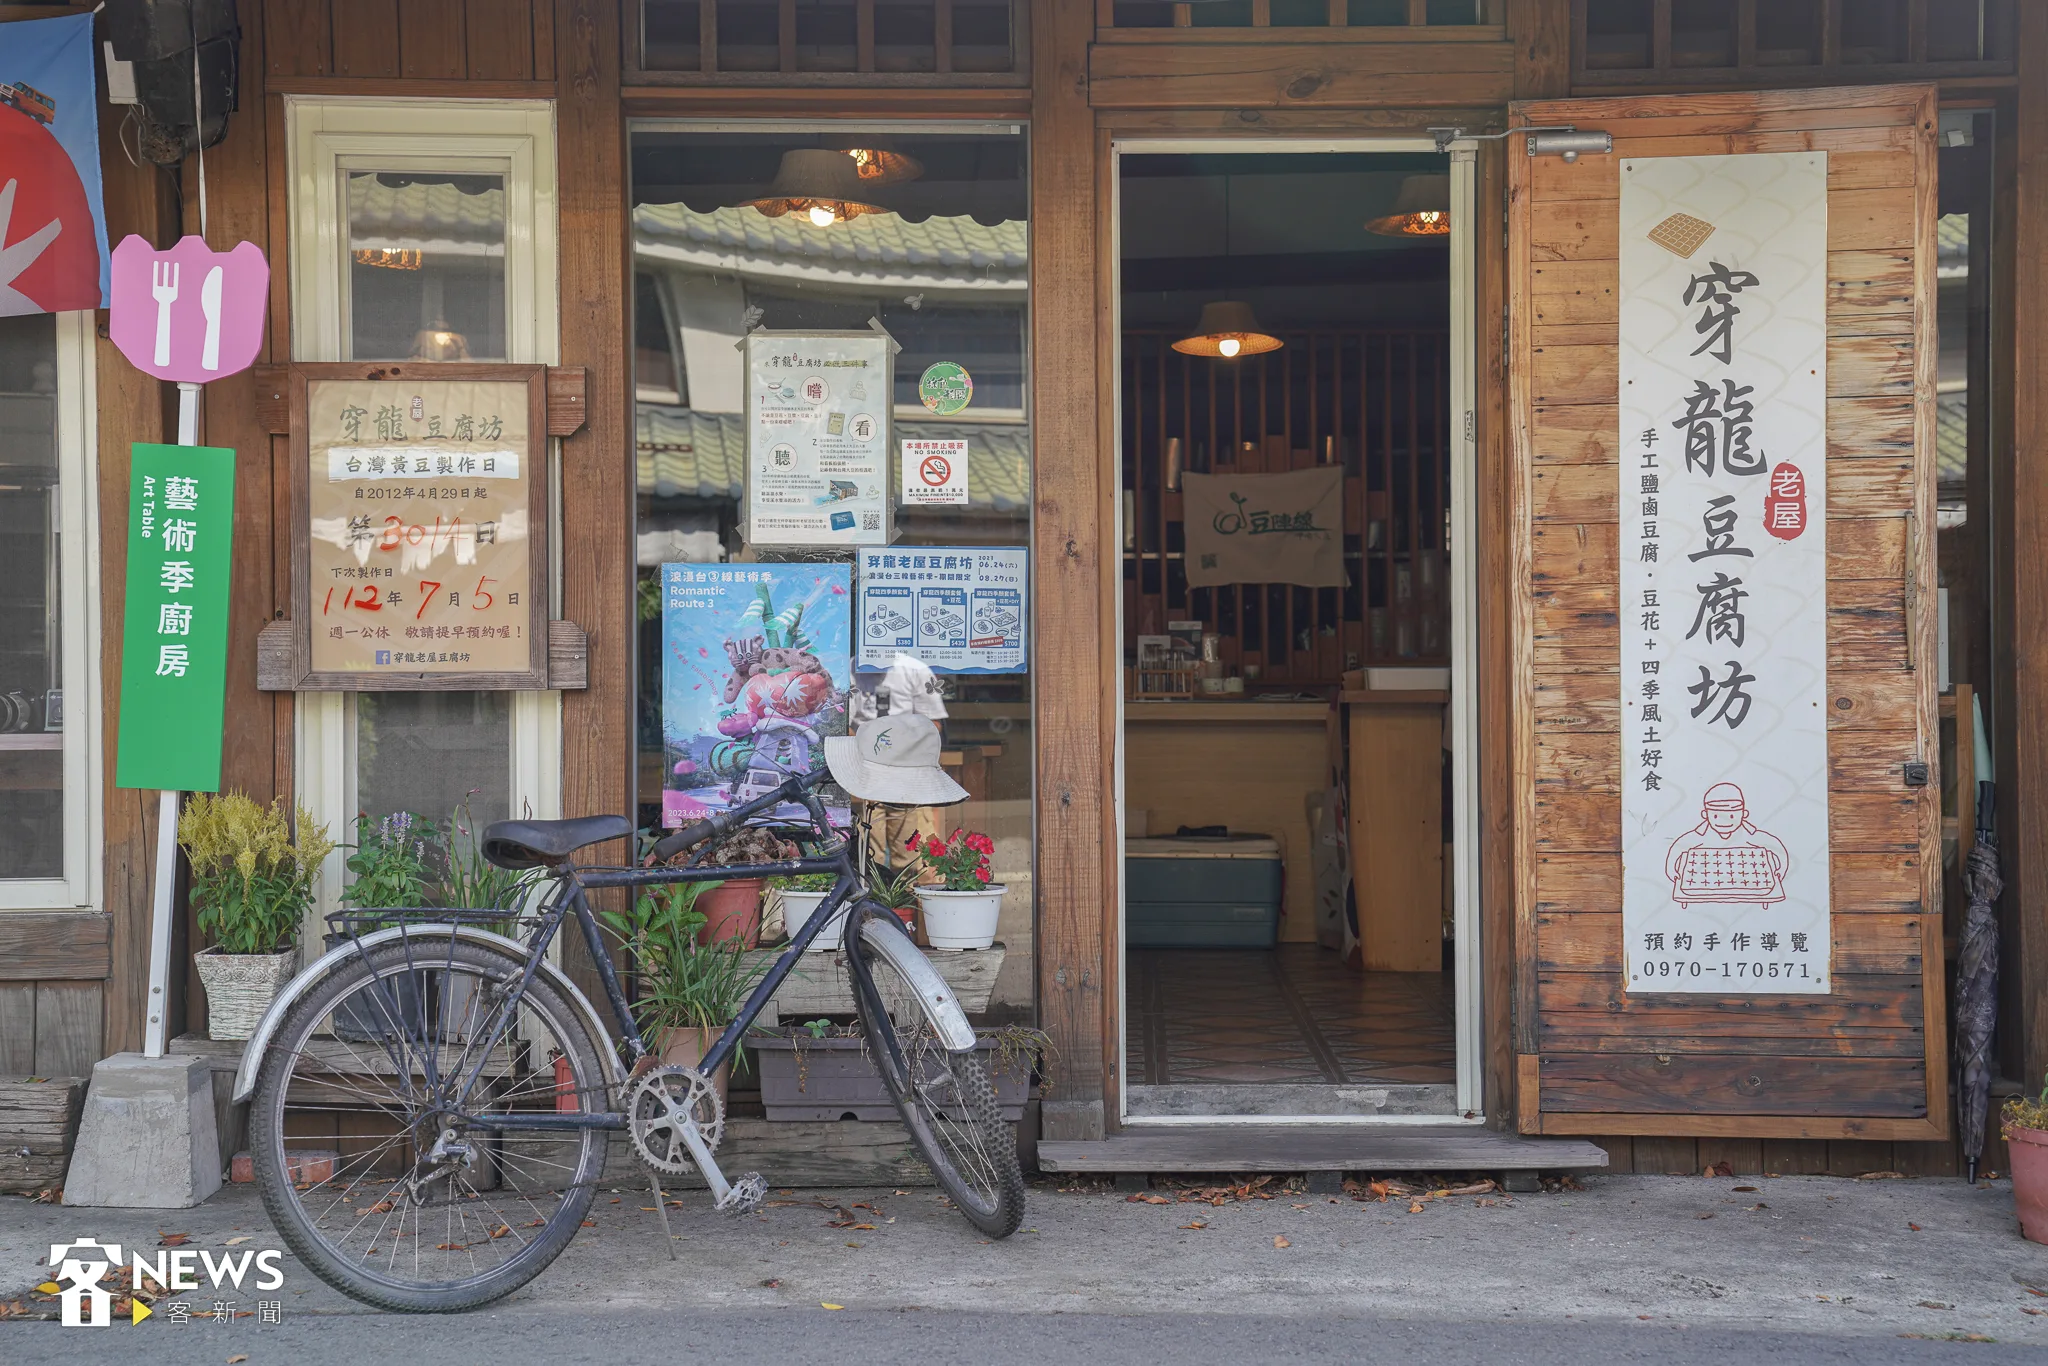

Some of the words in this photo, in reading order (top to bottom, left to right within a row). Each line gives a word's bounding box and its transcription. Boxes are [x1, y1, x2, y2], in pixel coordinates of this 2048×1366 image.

[412, 397, 424, 419] 老屋
[855, 419, 871, 437] 看
[906, 442, 964, 450] 本場所禁止吸菸
[346, 455, 496, 475] 台灣黃豆製作日
[143, 475, 156, 498] Art
[355, 486, 488, 499] 自2012年4月29日起
[1672, 261, 1767, 730] 穿龍豆腐坊
[1771, 470, 1801, 530] 老屋
[141, 500, 155, 539] Table
[867, 555, 973, 570] 穿龍老屋豆腐坊
[155, 475, 199, 678] 藝術季廚房
[331, 567, 394, 579] 下次製作日
[670, 586, 726, 595] Romantic
[670, 599, 705, 608] Route
[707, 599, 714, 608] 3
[330, 626, 391, 640] 週一公休
[393, 651, 471, 664] 穿龍老屋豆腐坊
[1644, 932, 1809, 952] 預約手作導覽
[1644, 961, 1810, 978] 0970-170571
